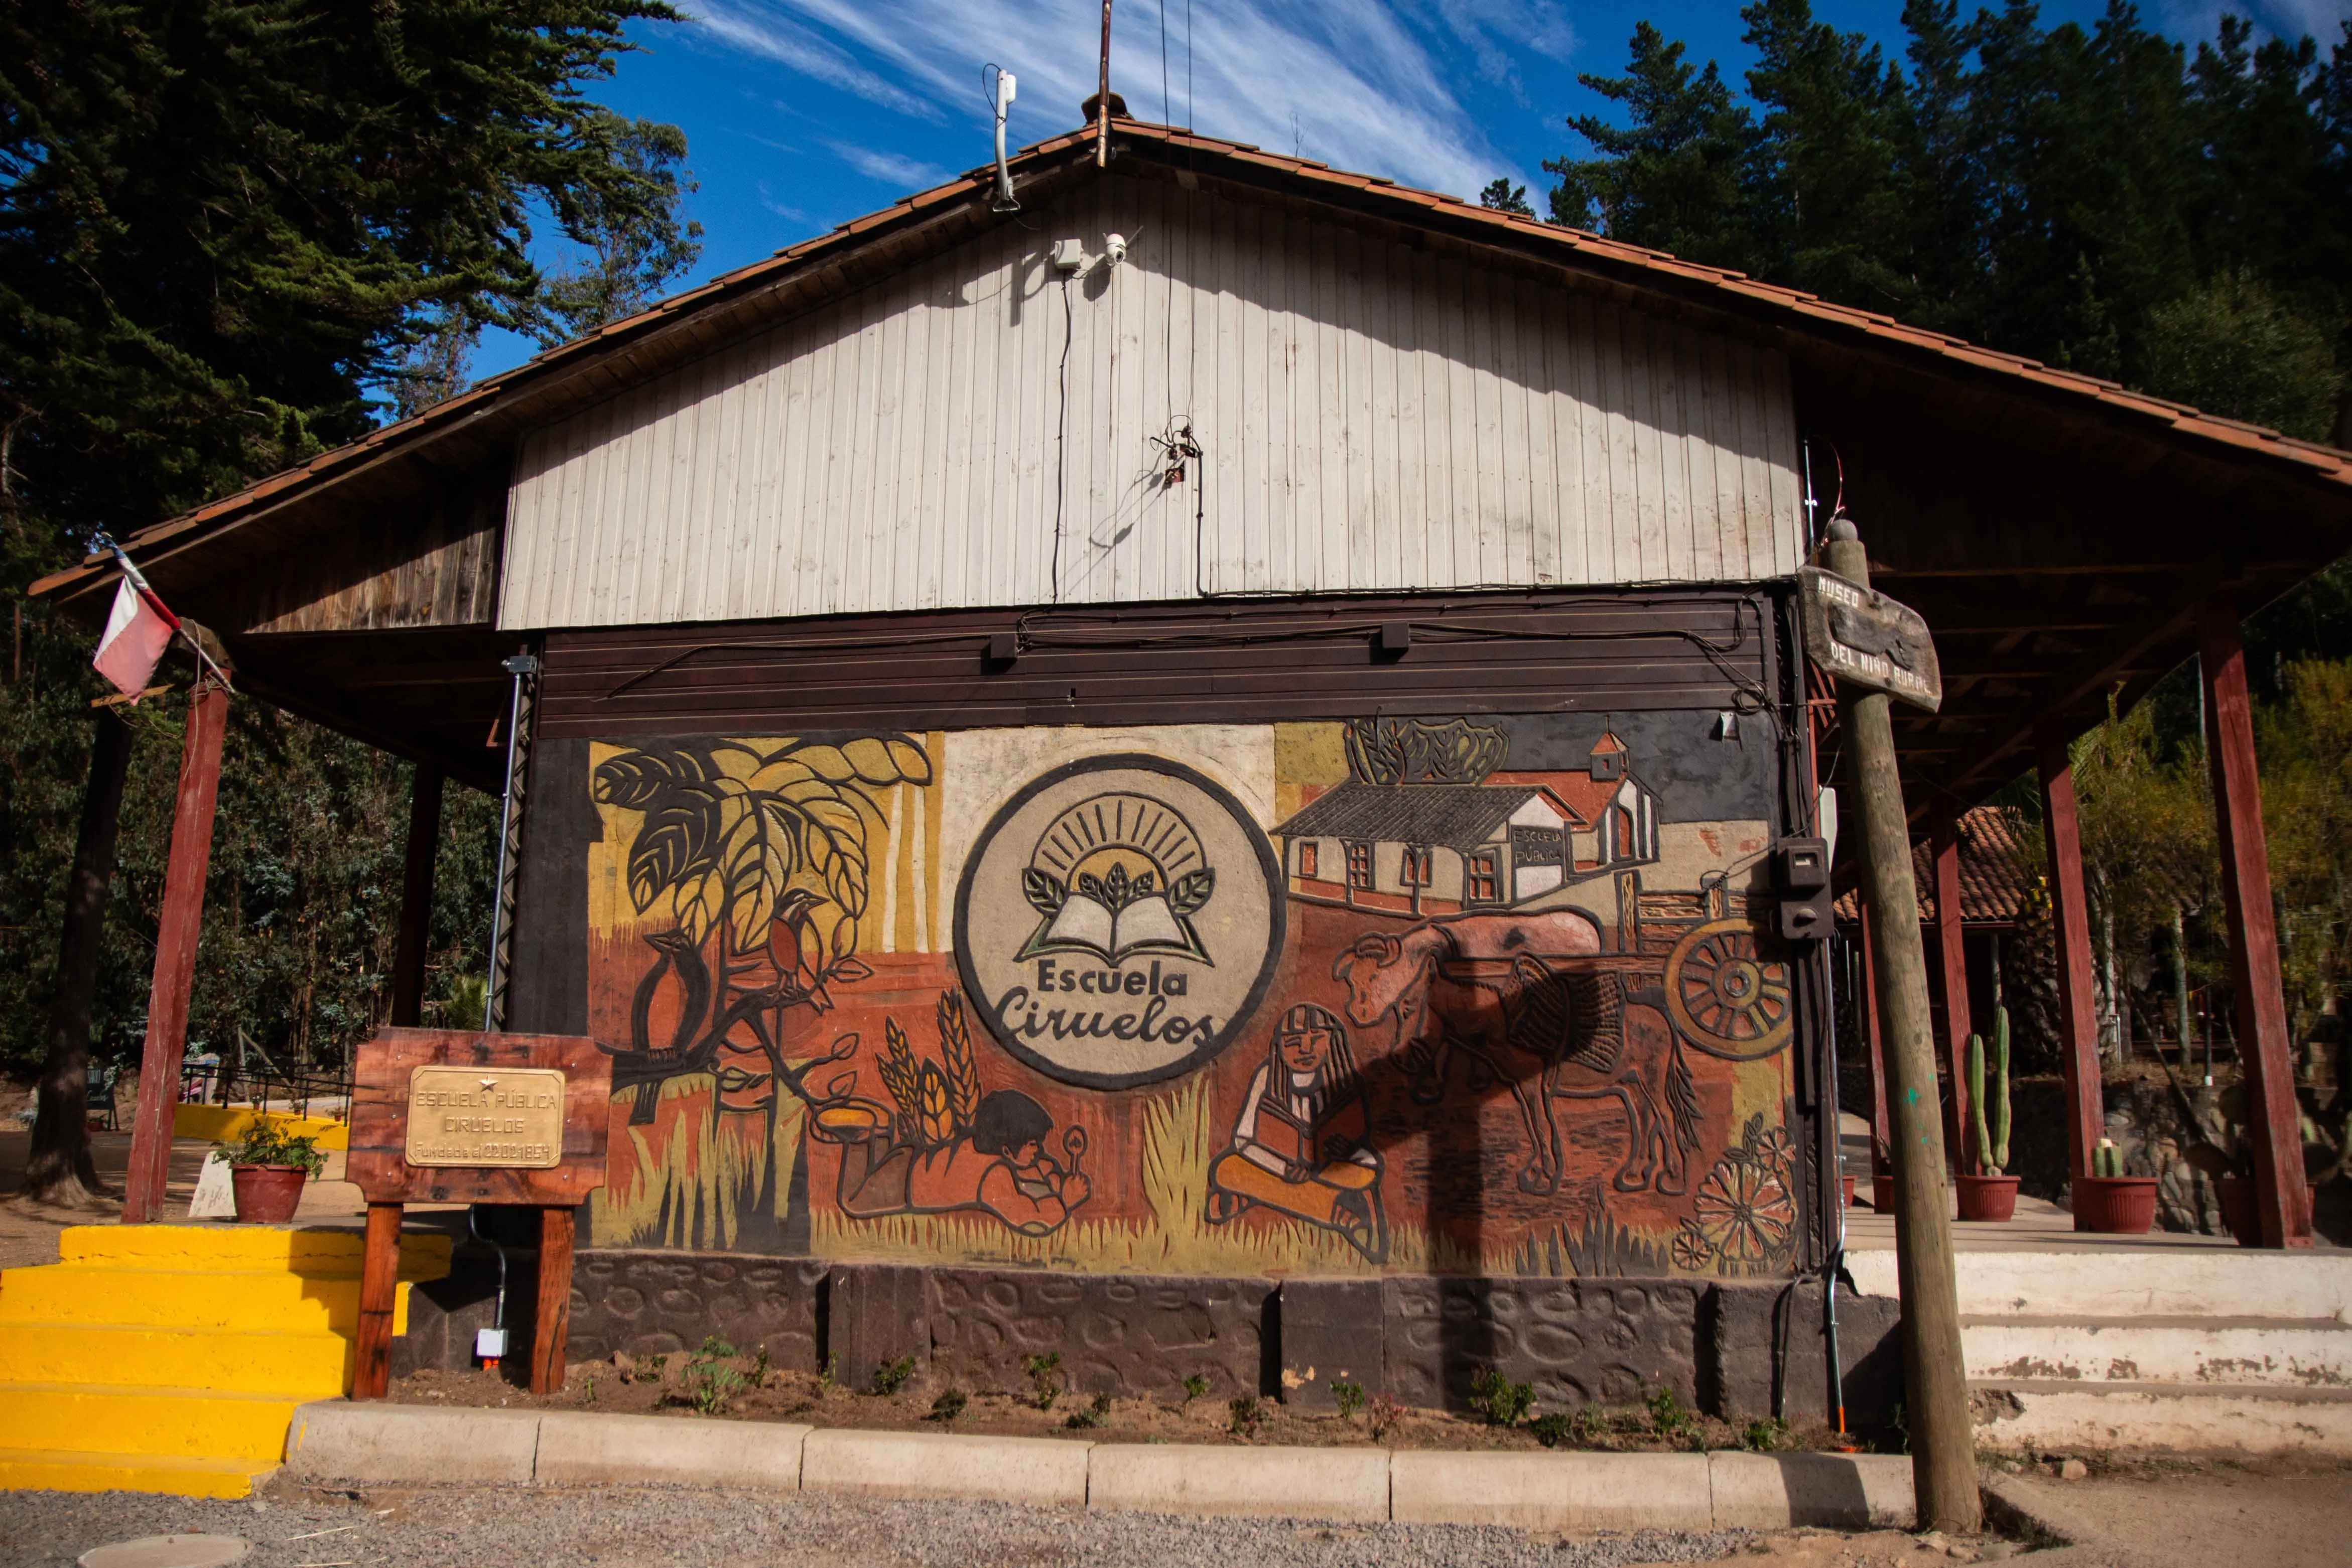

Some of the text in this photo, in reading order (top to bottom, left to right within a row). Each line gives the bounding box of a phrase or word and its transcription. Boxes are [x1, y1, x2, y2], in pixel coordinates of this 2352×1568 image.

[1818, 576, 1859, 607] MUSEO
[1831, 641, 1855, 667] DEL
[1894, 666, 1932, 694] RURAL
[1037, 959, 1188, 996] Escuela
[995, 985, 1214, 1046] Ciruelos
[416, 1088, 557, 1109] ESCUELA PÚBLICA
[445, 1116, 525, 1133] CIRUELOS
